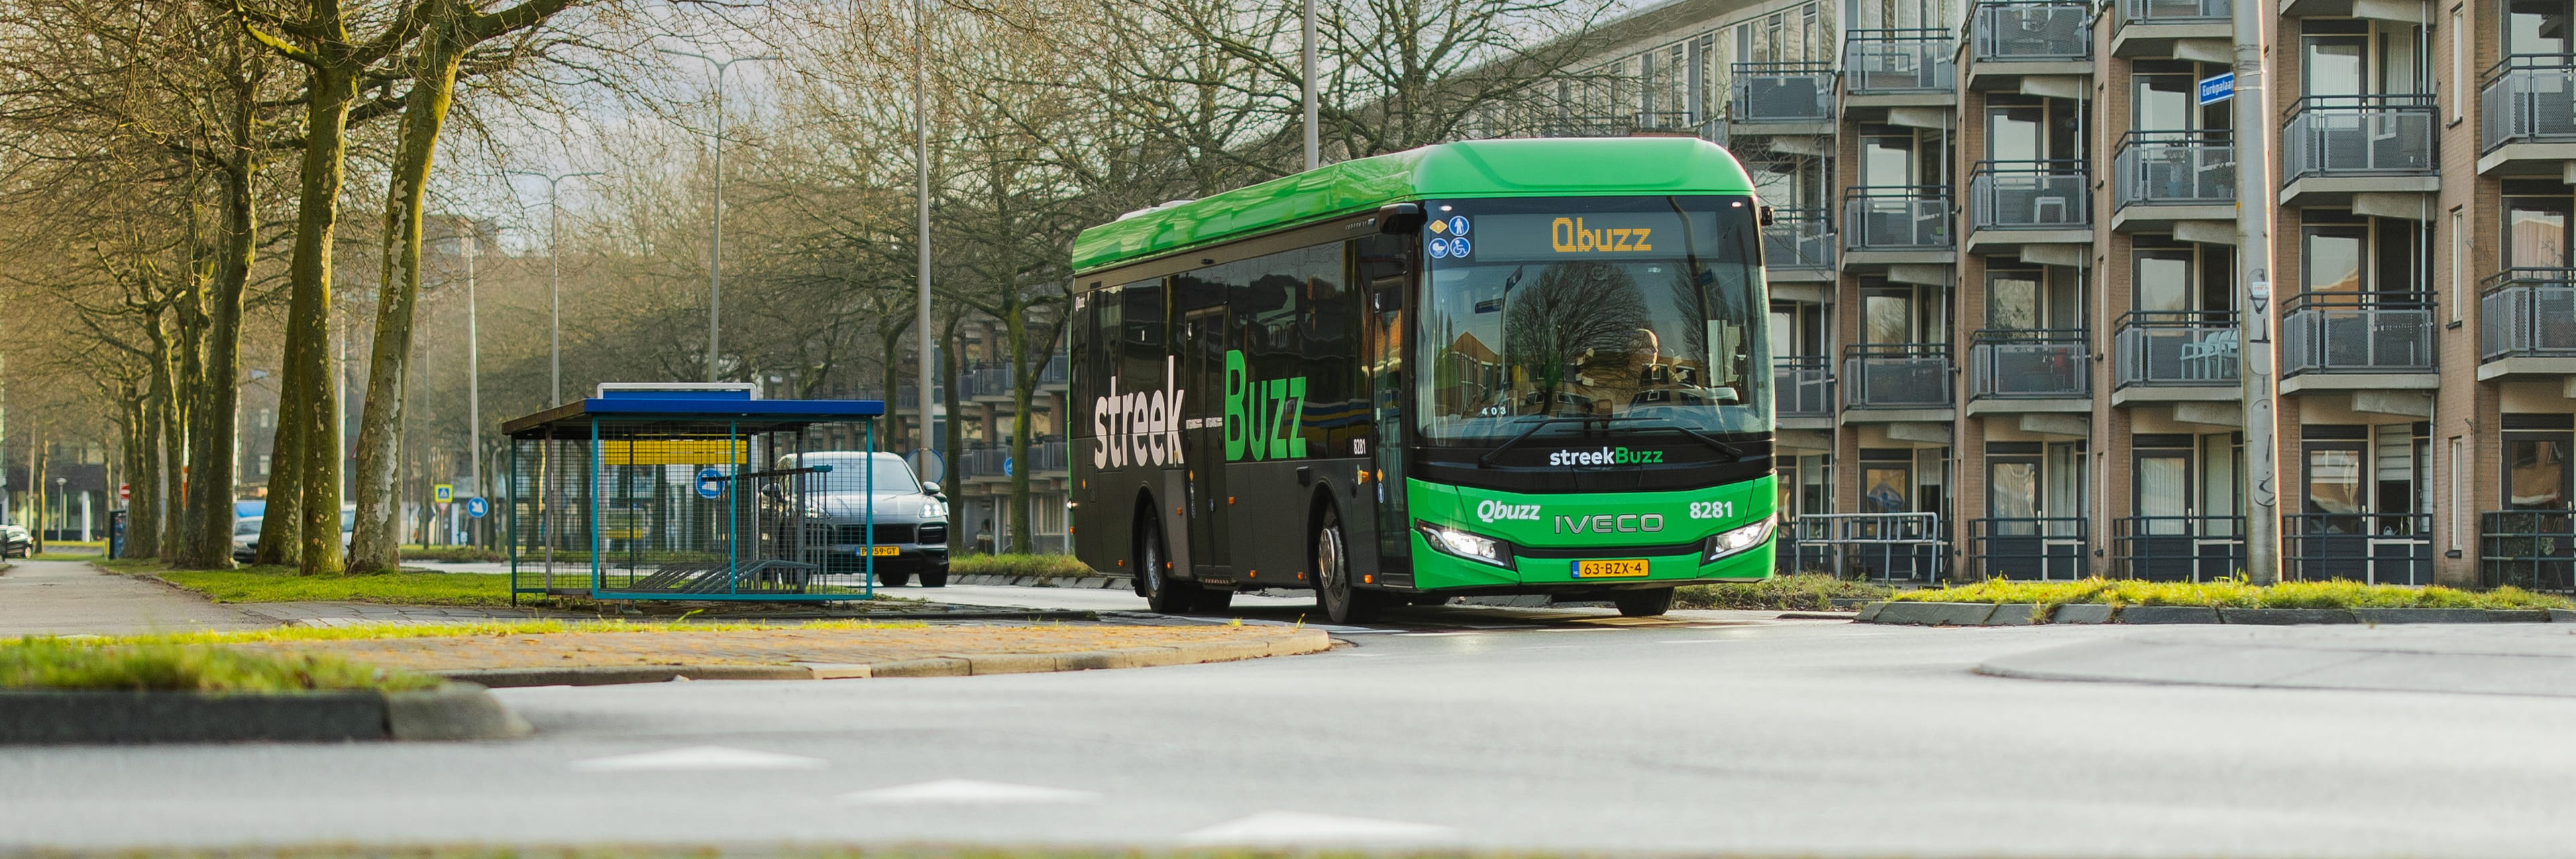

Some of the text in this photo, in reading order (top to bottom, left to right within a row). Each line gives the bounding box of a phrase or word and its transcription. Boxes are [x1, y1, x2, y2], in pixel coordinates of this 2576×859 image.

[1552, 217, 1652, 252] Qbuzz
[1094, 349, 1307, 469] streek Buzz
[1353, 438, 1366, 455] 8281
[1550, 446, 1663, 466] streekBuzz
[1477, 499, 1541, 523] Qbuzz
[1689, 501, 1733, 519] 8281
[1554, 513, 1664, 535] IVECO
[861, 547, 897, 555] P59-GT
[1584, 562, 1642, 575] 63-BZX-4
